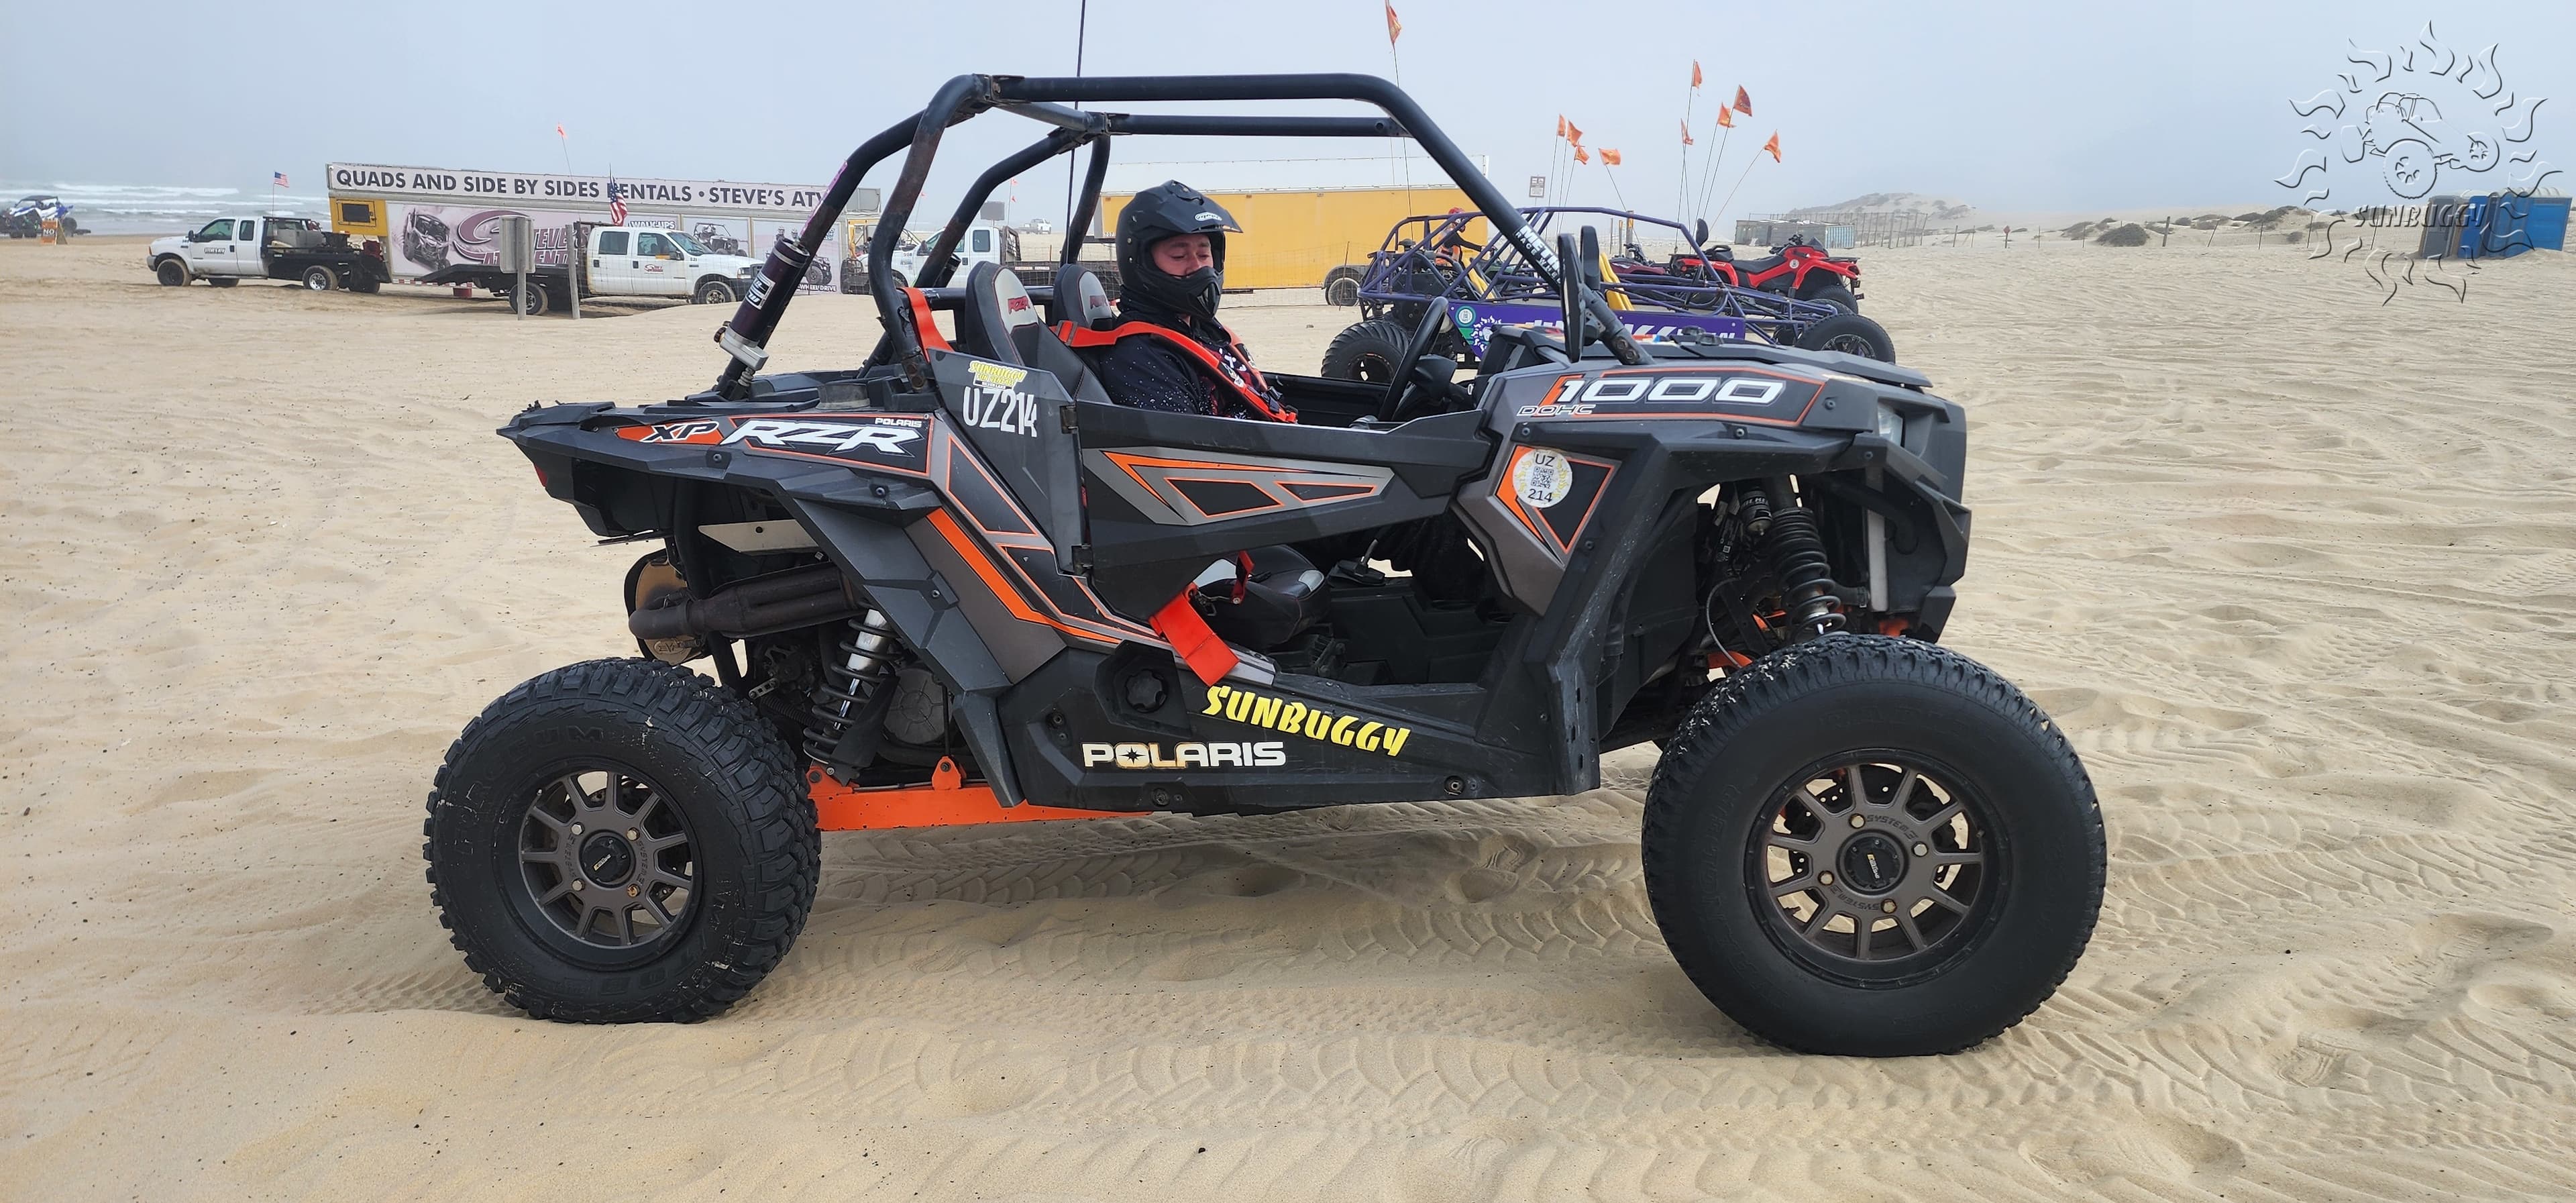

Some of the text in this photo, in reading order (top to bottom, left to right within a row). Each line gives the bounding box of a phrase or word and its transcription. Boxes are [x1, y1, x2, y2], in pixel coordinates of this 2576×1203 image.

[336, 170, 406, 188] QUADS
[412, 174, 457, 190] AND
[464, 176, 507, 193] SIDE
[514, 178, 538, 195] BY
[545, 180, 600, 197] SIDES
[709, 187, 785, 206] STEVE'S
[629, 220, 676, 229] WALK-UPS
[1515, 231, 1538, 256] RACE
[1519, 225, 1560, 274] METH
[1557, 379, 1784, 404] 1000
[874, 417, 922, 428] POLARIS
[963, 386, 1038, 437] UZ214
[1516, 404, 1596, 417] DOHC
[639, 419, 922, 456] XP RZR
[1534, 453, 1556, 468] UZ
[1527, 488, 1553, 503] 214
[1201, 685, 1411, 756] SUNBUGGY
[1082, 741, 1287, 768] POLARIS
[1867, 814, 1908, 831] SYSTEM
